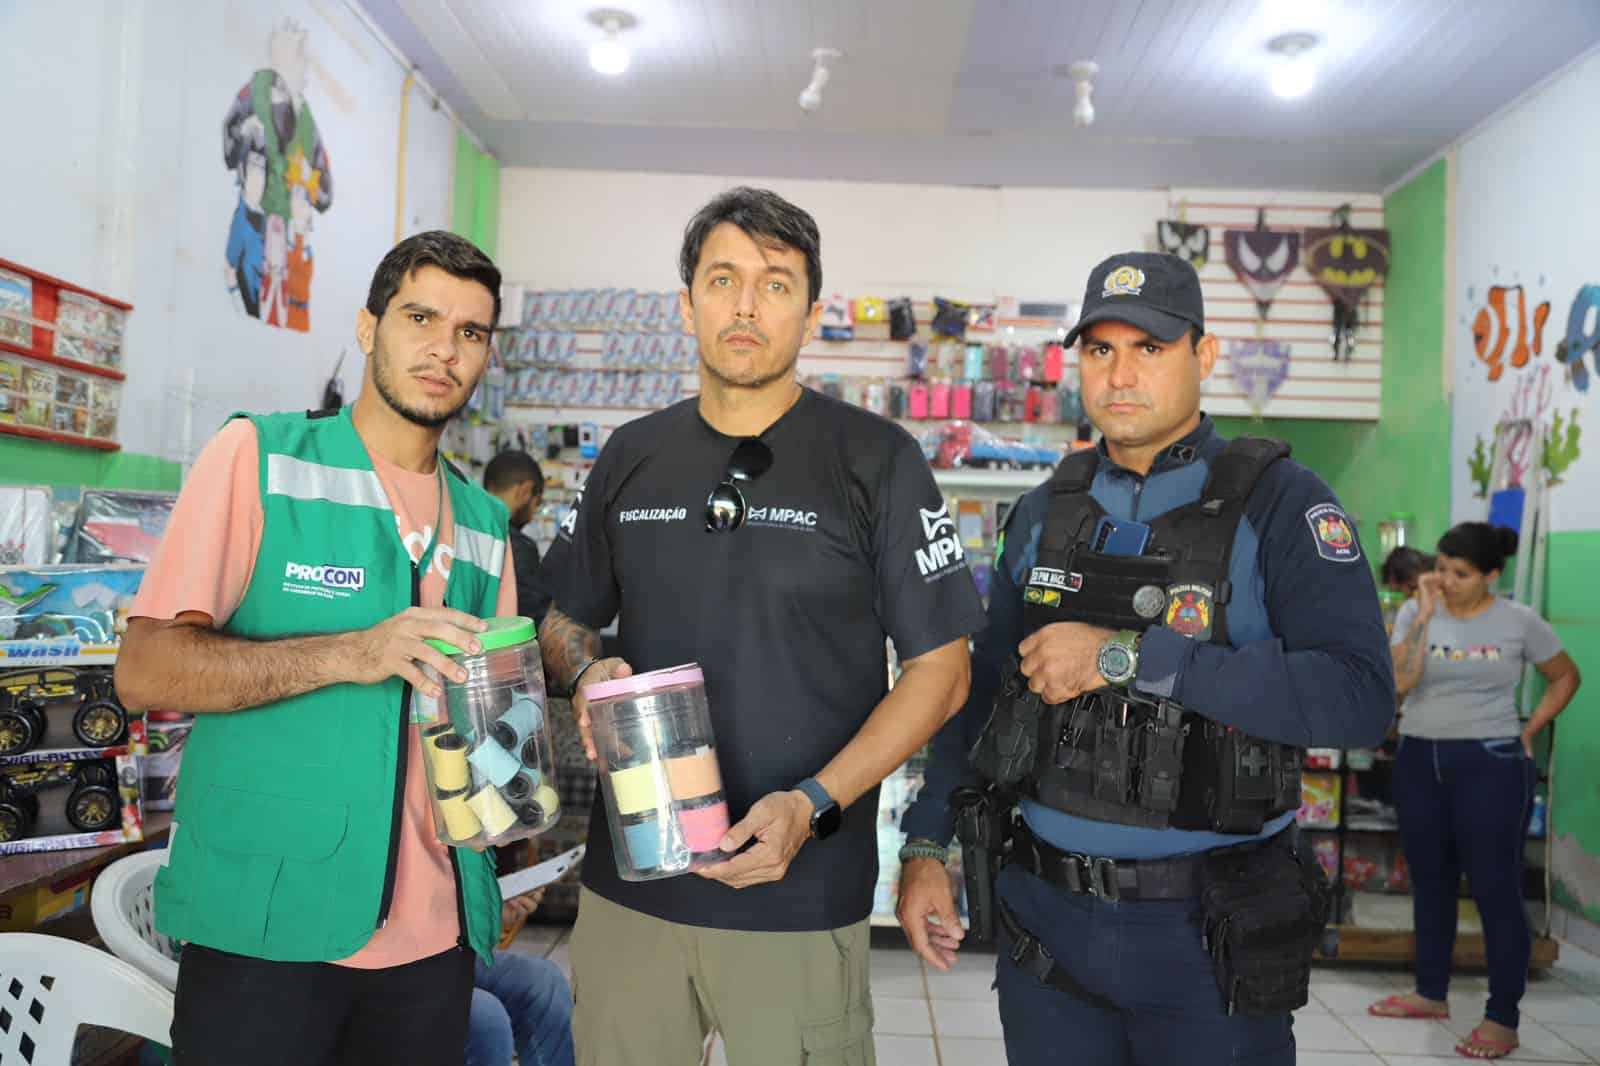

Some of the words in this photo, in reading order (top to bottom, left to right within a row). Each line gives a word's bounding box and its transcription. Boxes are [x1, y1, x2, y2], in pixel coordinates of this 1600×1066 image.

[620, 507, 687, 523] FISCALIZAÇÃO
[769, 508, 817, 526] MPAC
[285, 561, 361, 585] PROCON
